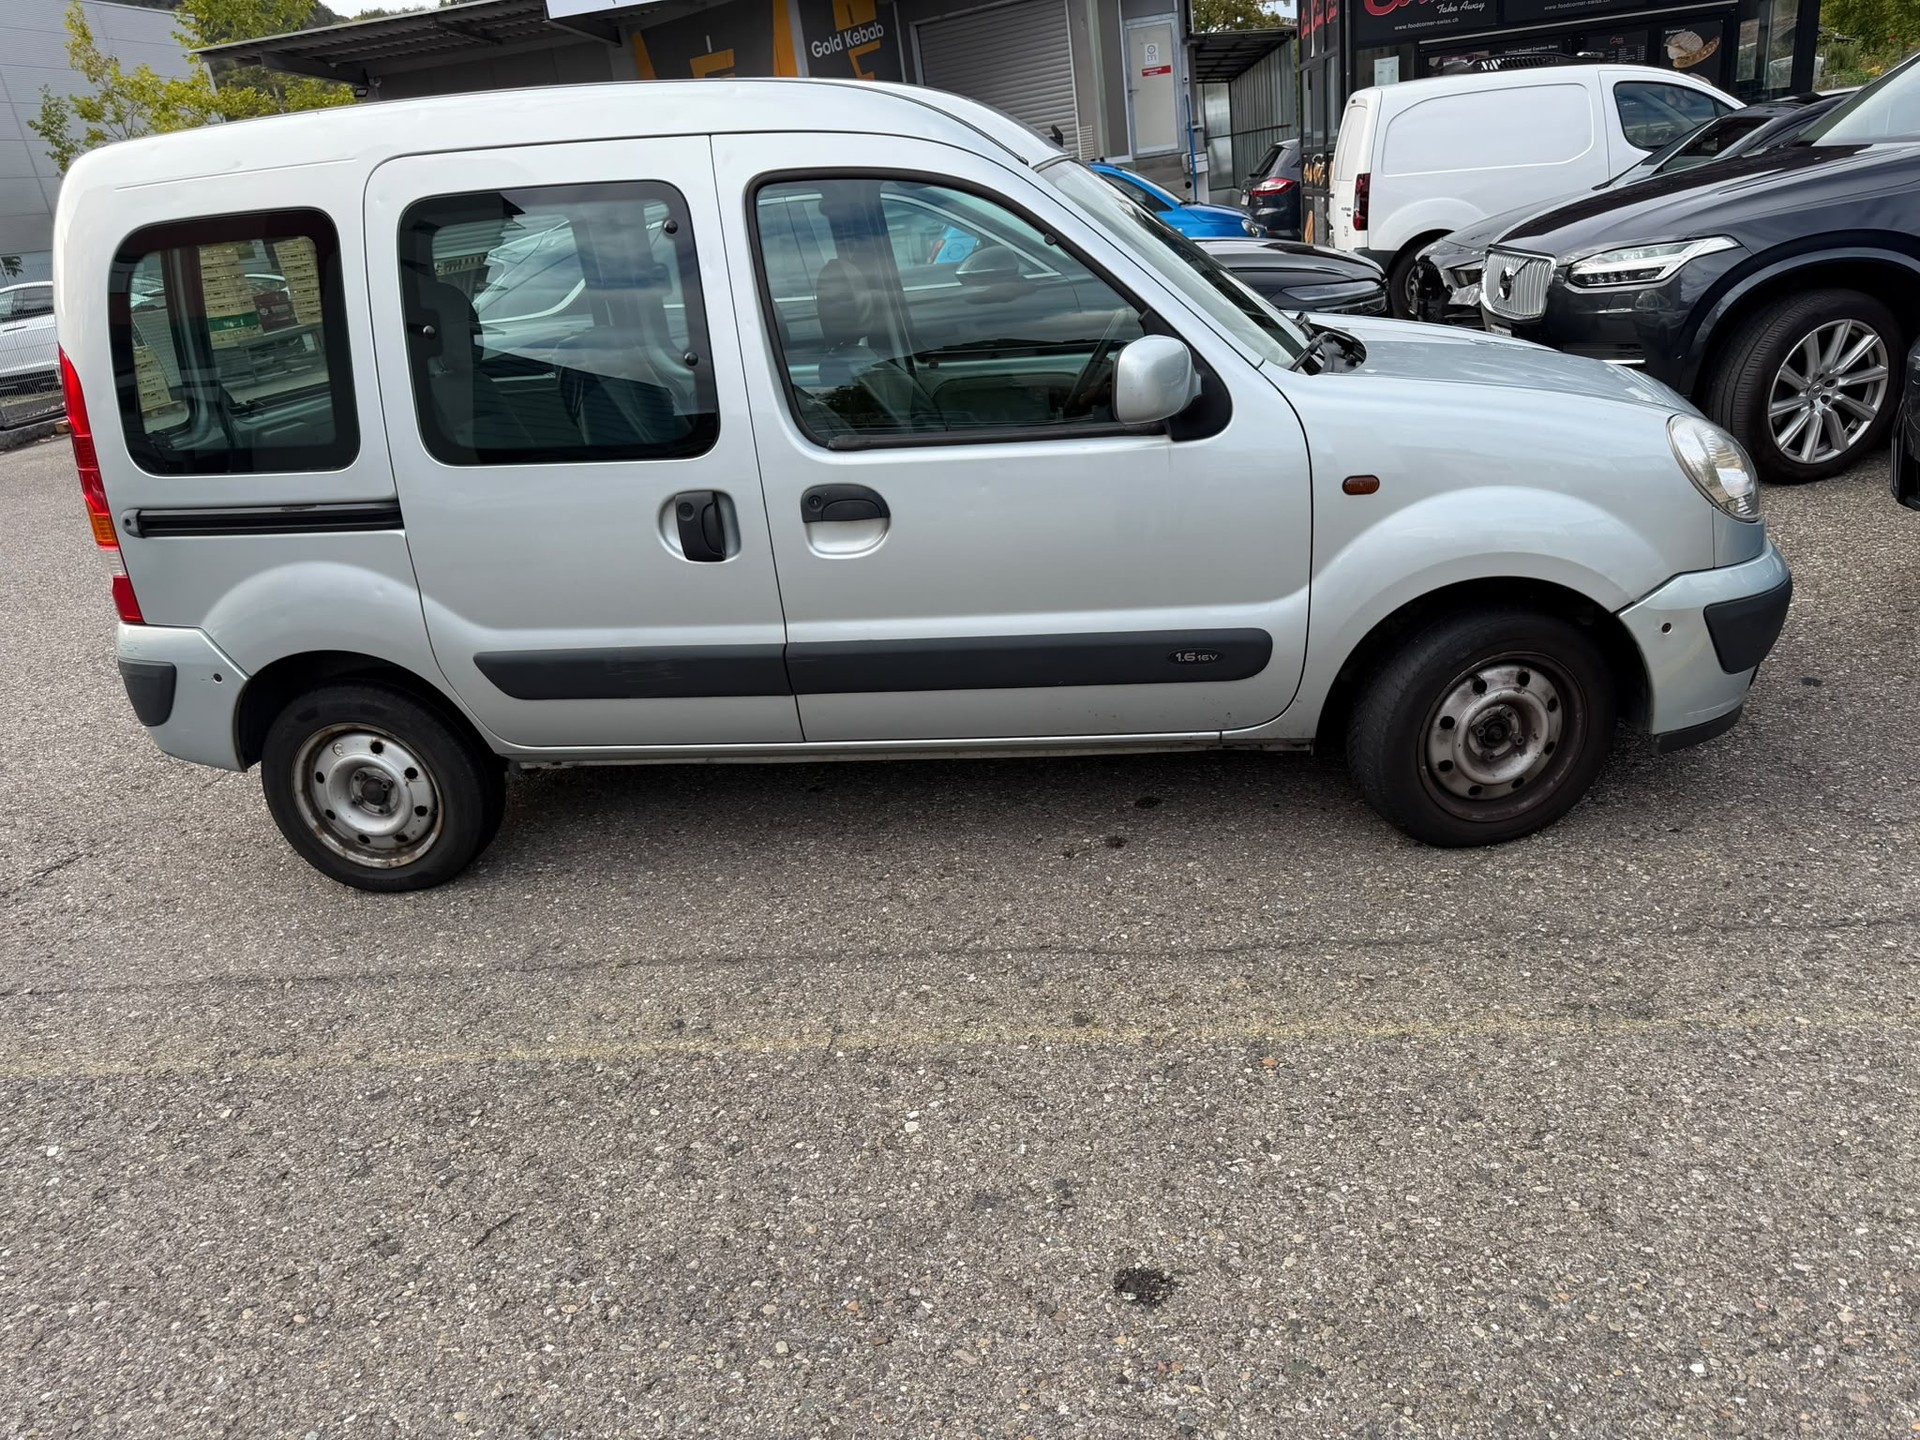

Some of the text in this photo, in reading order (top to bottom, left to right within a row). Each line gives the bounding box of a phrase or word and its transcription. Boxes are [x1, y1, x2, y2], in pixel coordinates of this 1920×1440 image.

[1436, 4, 1458, 14] Take
[1460, 1, 1485, 12] Away
[1394, 17, 1459, 30] www.foodcorner-swiss.ch
[811, 22, 884, 58] Gold Kebab
[1175, 652, 1196, 662] 1.6
